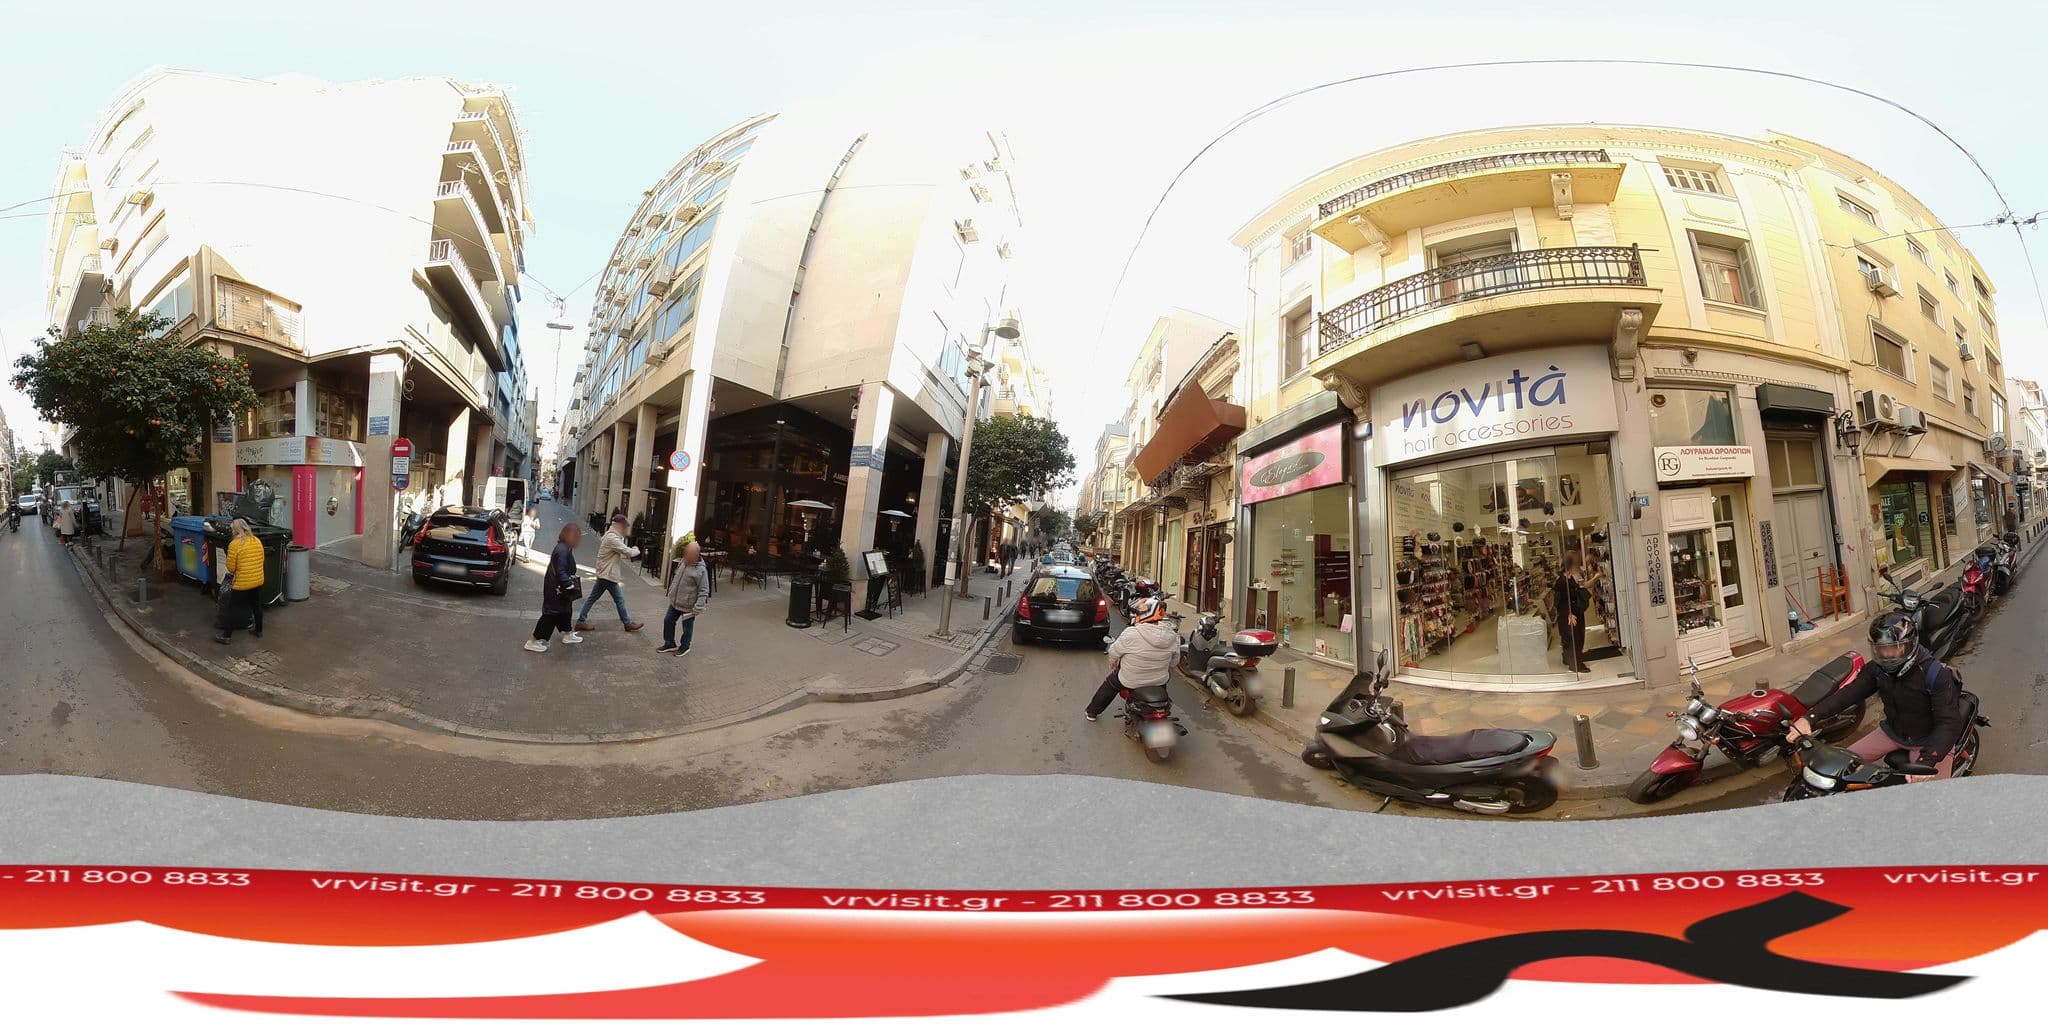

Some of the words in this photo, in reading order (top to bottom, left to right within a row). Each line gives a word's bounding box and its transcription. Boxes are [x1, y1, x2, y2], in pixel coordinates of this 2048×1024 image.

[1402, 364, 1567, 432] novità
[1403, 434, 1440, 455] hair
[1444, 414, 1573, 446] accessories
[1661, 457, 1679, 471] RG
[1768, 577, 1778, 586] 45
[1651, 595, 1665, 604] 45
